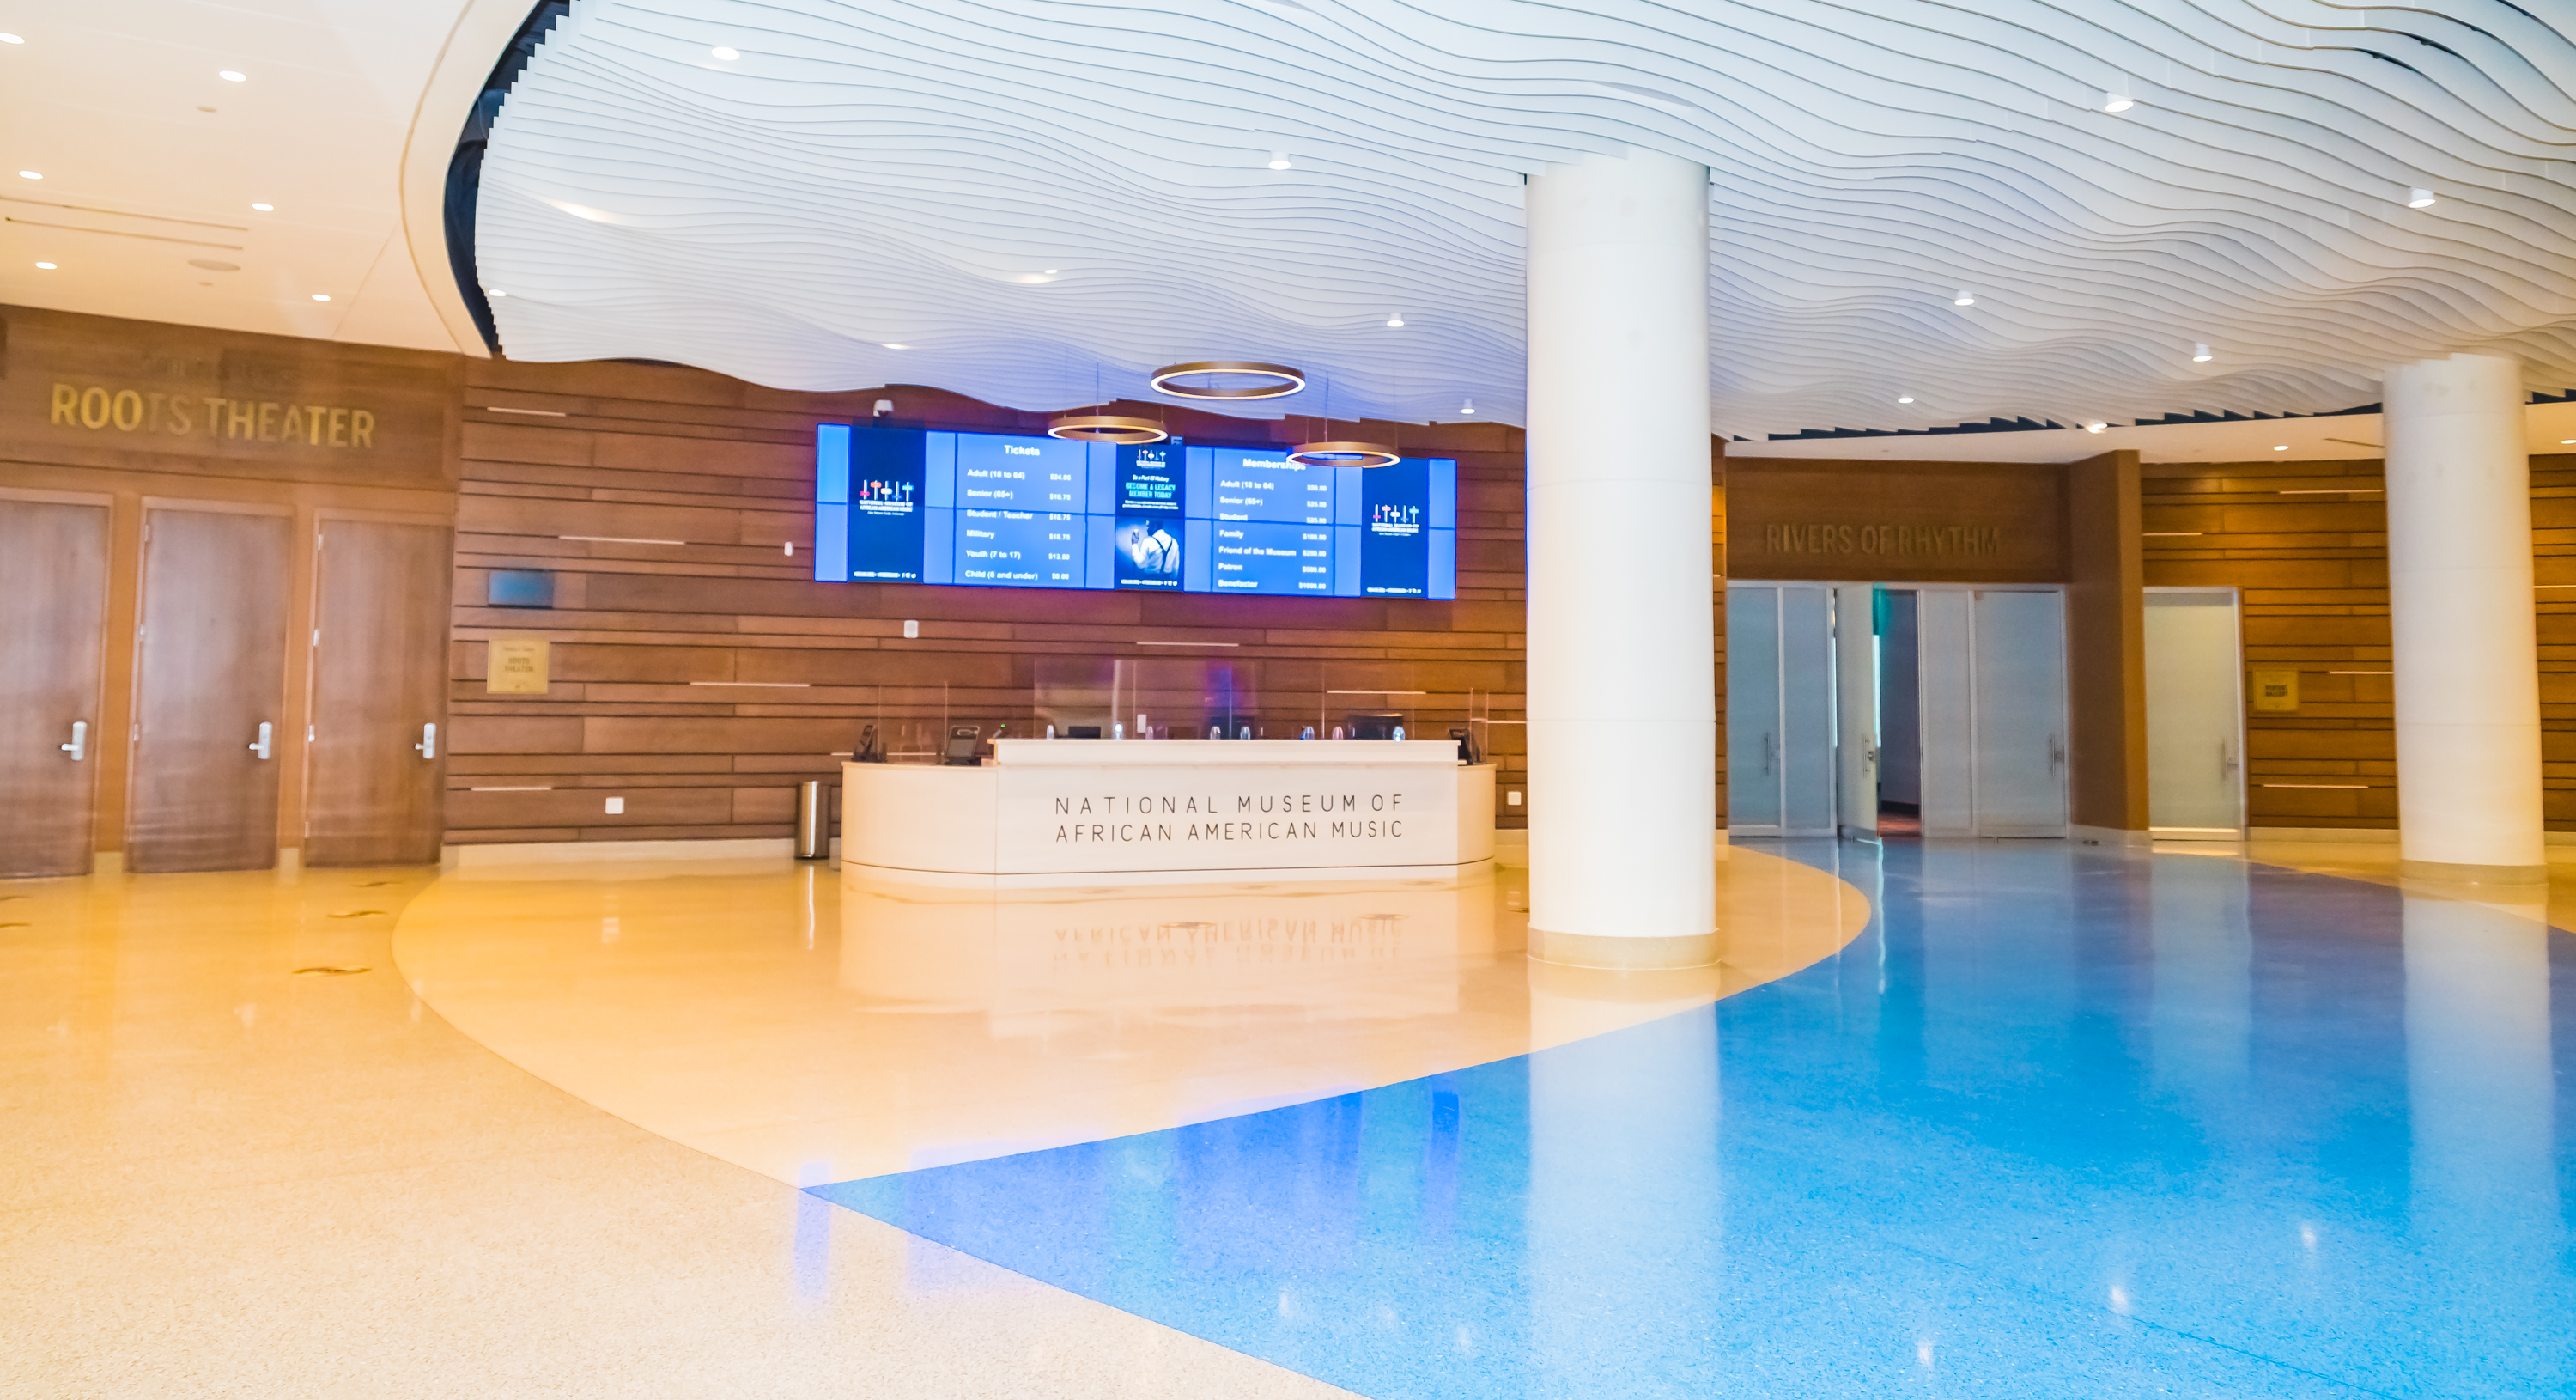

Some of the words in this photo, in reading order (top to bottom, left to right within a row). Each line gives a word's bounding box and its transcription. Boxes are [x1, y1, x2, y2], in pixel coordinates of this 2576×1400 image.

[50, 382, 191, 435] ROOTS
[203, 397, 374, 448] THEATER
[1004, 445, 1040, 456] Tickets
[1243, 458, 1306, 471] Memberships
[967, 469, 988, 477] Adult
[966, 530, 995, 539] Military
[1219, 530, 1244, 539] Family
[1766, 524, 1853, 554] RIVERS
[1861, 525, 1889, 554] OF
[1898, 525, 1999, 555] RHYTHM
[1055, 796, 1218, 815] NATIONAL
[1237, 795, 1356, 813] MUSEUM
[1371, 794, 1402, 812] OF
[1055, 824, 1172, 843] AFRICAN
[1188, 822, 1317, 841] AMERICAN
[1332, 821, 1403, 838] MUSIC
